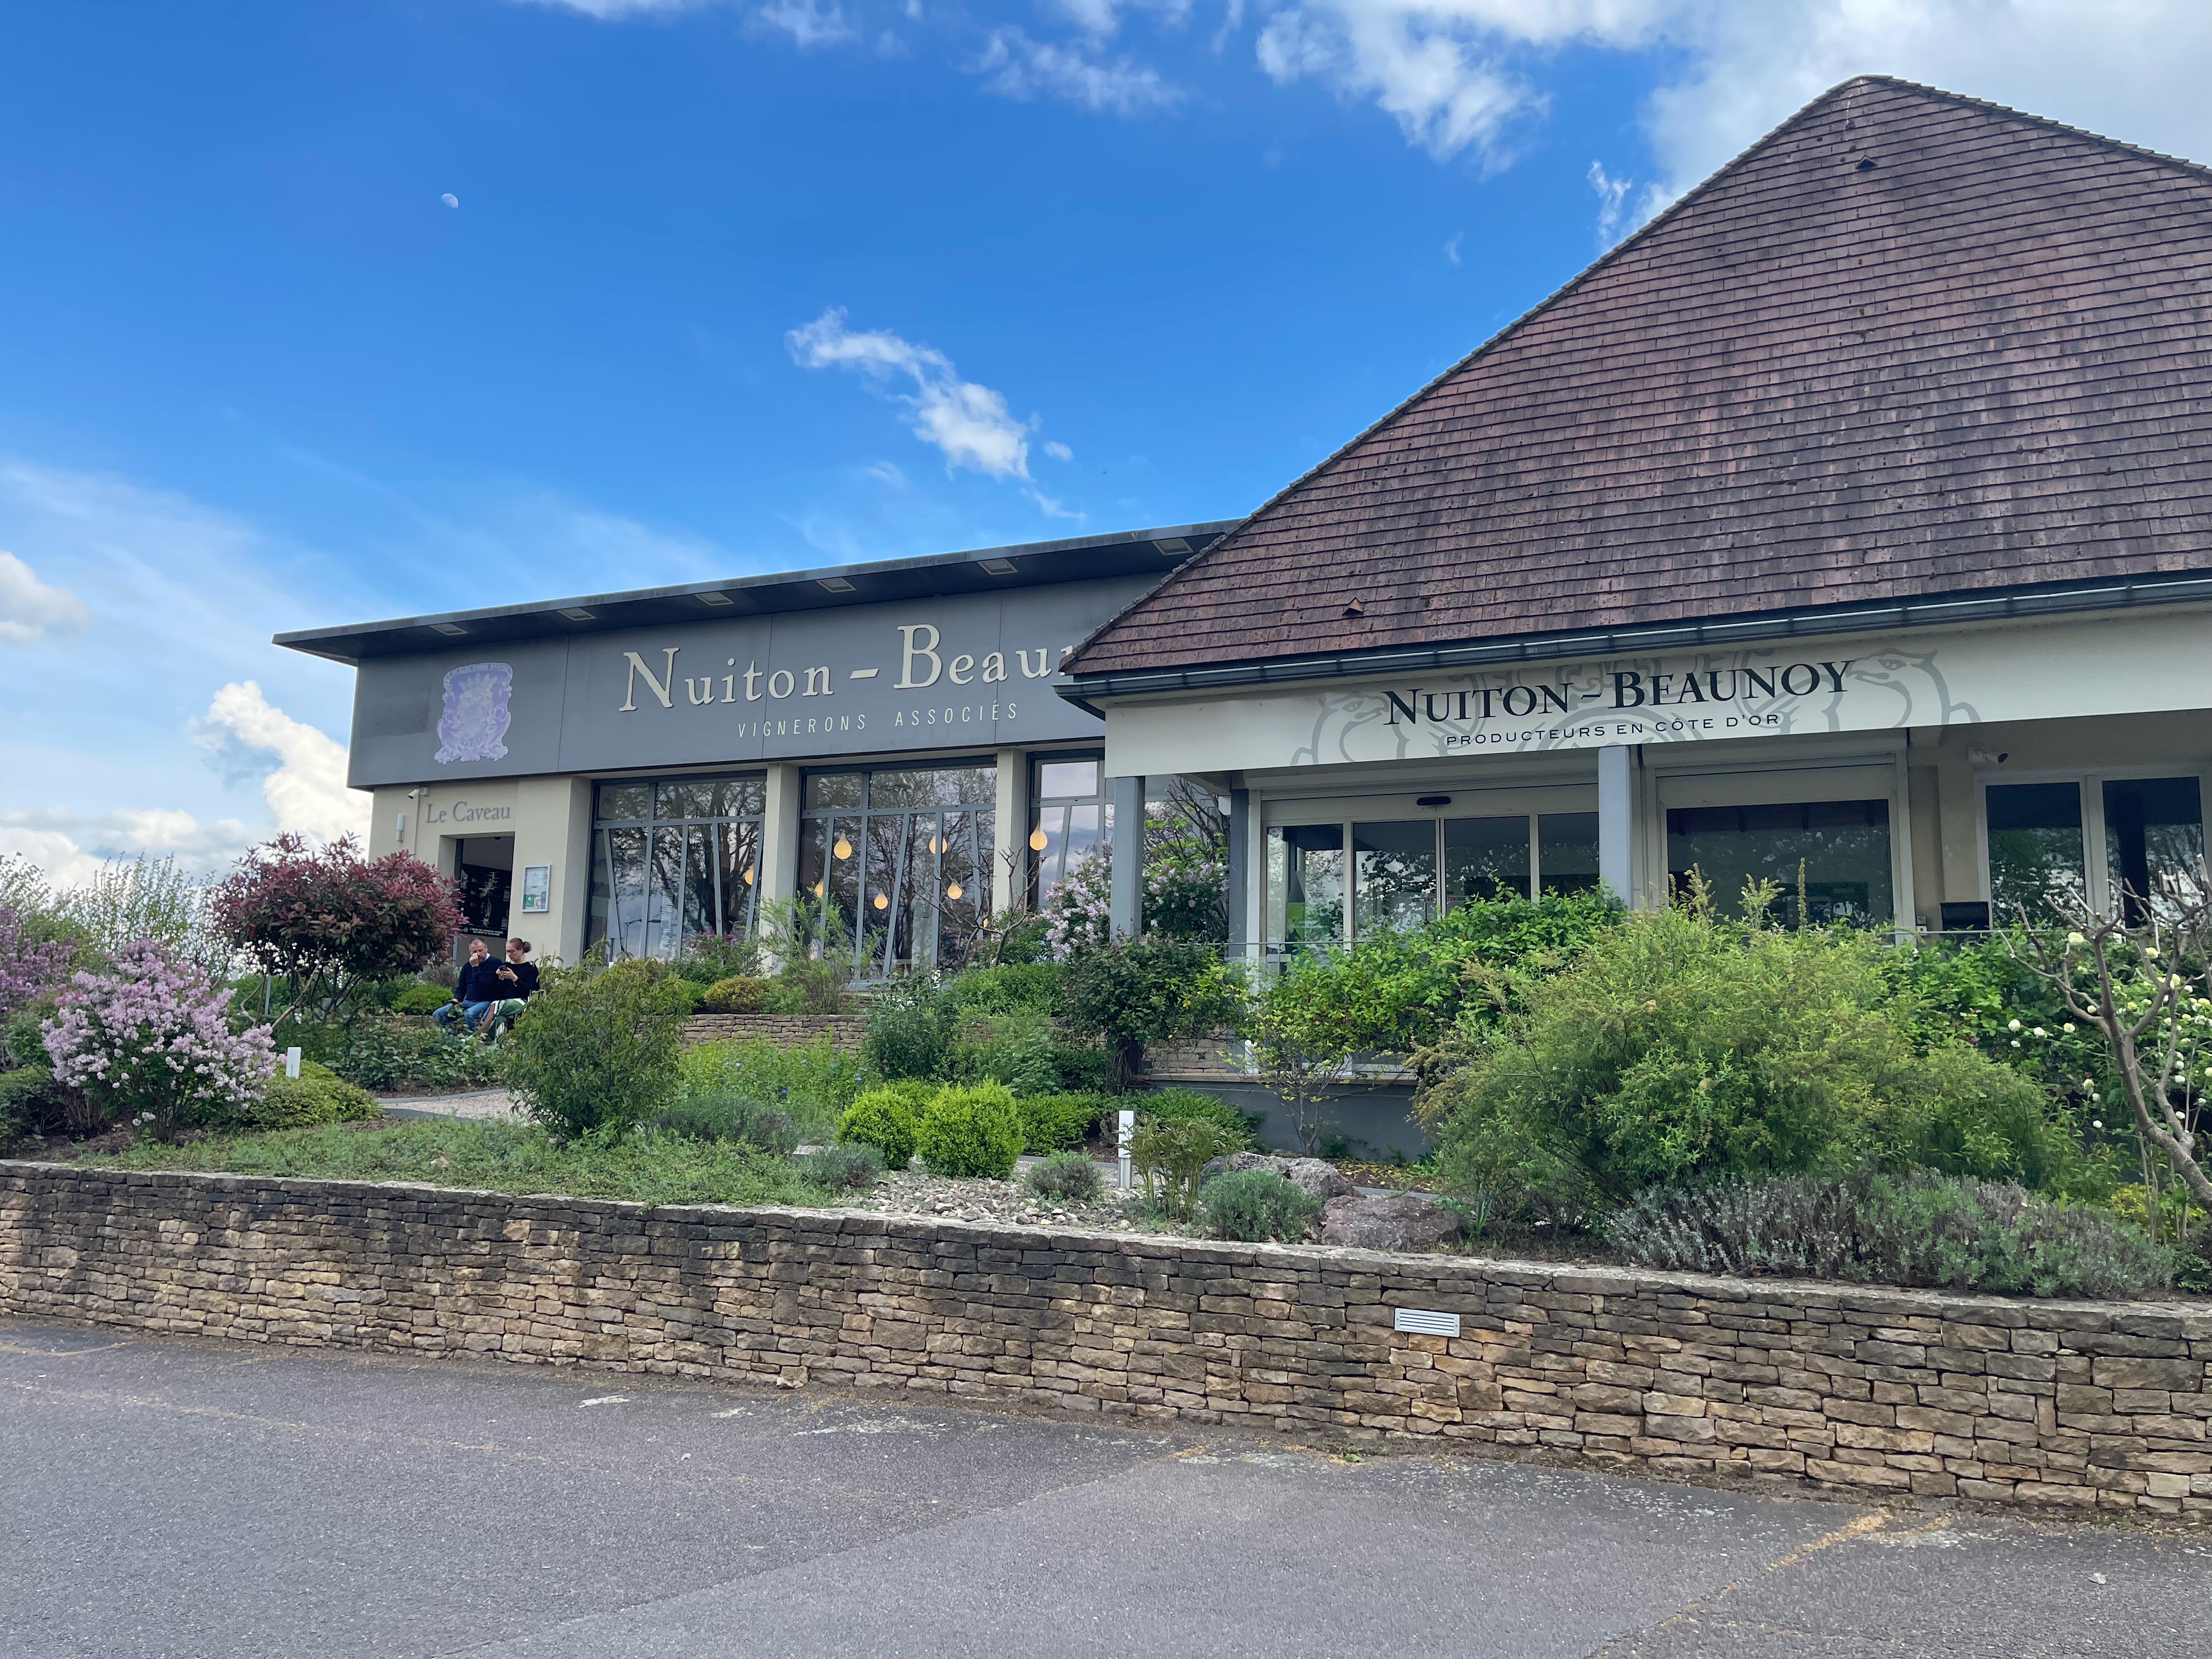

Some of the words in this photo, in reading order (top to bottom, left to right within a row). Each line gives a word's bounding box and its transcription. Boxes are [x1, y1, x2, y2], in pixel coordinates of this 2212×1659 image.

[618, 646, 834, 712] Nuiton
[893, 623, 1074, 689] Beau
[1381, 682, 1573, 725] NUITON
[1606, 659, 1857, 709] BEAUNOY
[737, 713, 866, 738] VIGNERONS
[894, 702, 1017, 727] ASSOCIÉS
[1446, 726, 1605, 747] PRODUCTEURS
[1616, 723, 1643, 735] EN
[1655, 717, 1714, 732] CÔTE
[1726, 714, 1779, 728] D’OR
[426, 803, 447, 823] Le
[453, 801, 510, 822] Caveau
